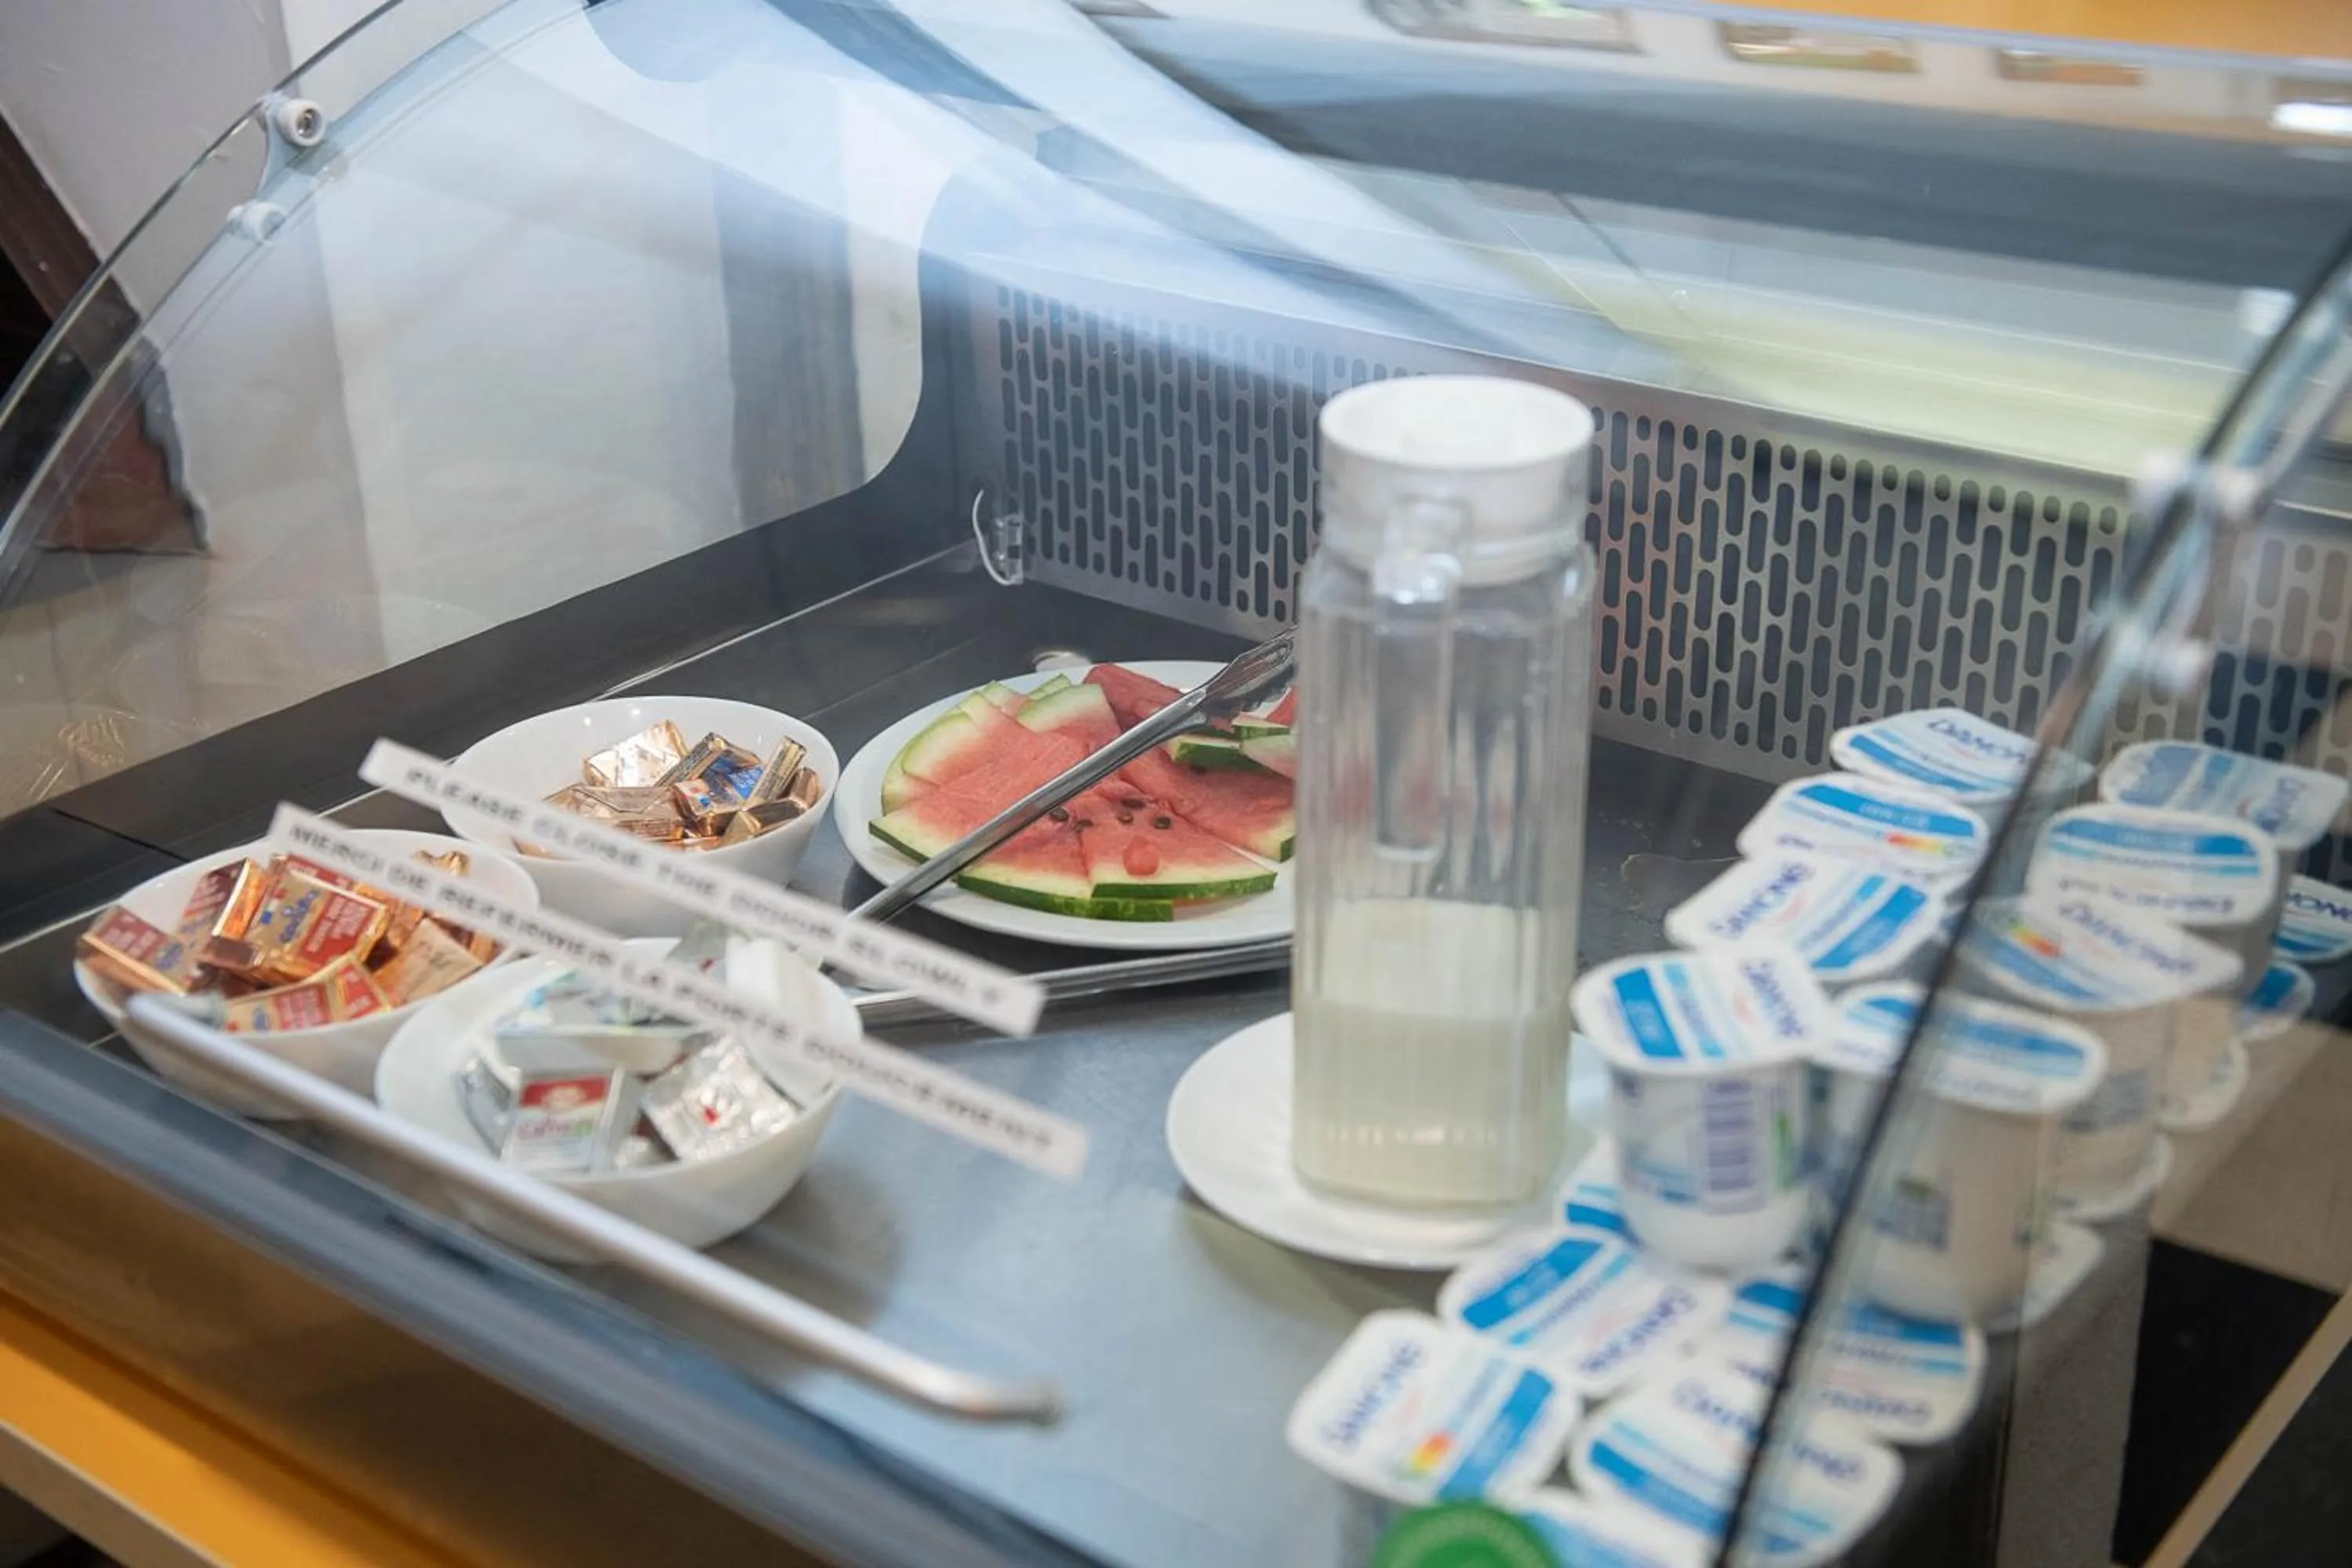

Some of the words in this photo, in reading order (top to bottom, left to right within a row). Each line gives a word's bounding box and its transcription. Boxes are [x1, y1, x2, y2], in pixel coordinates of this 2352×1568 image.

[287, 818, 387, 877] MERCI
[384, 860, 430, 896] DE
[402, 763, 526, 828] PLEASE
[528, 812, 644, 875] CLOSE
